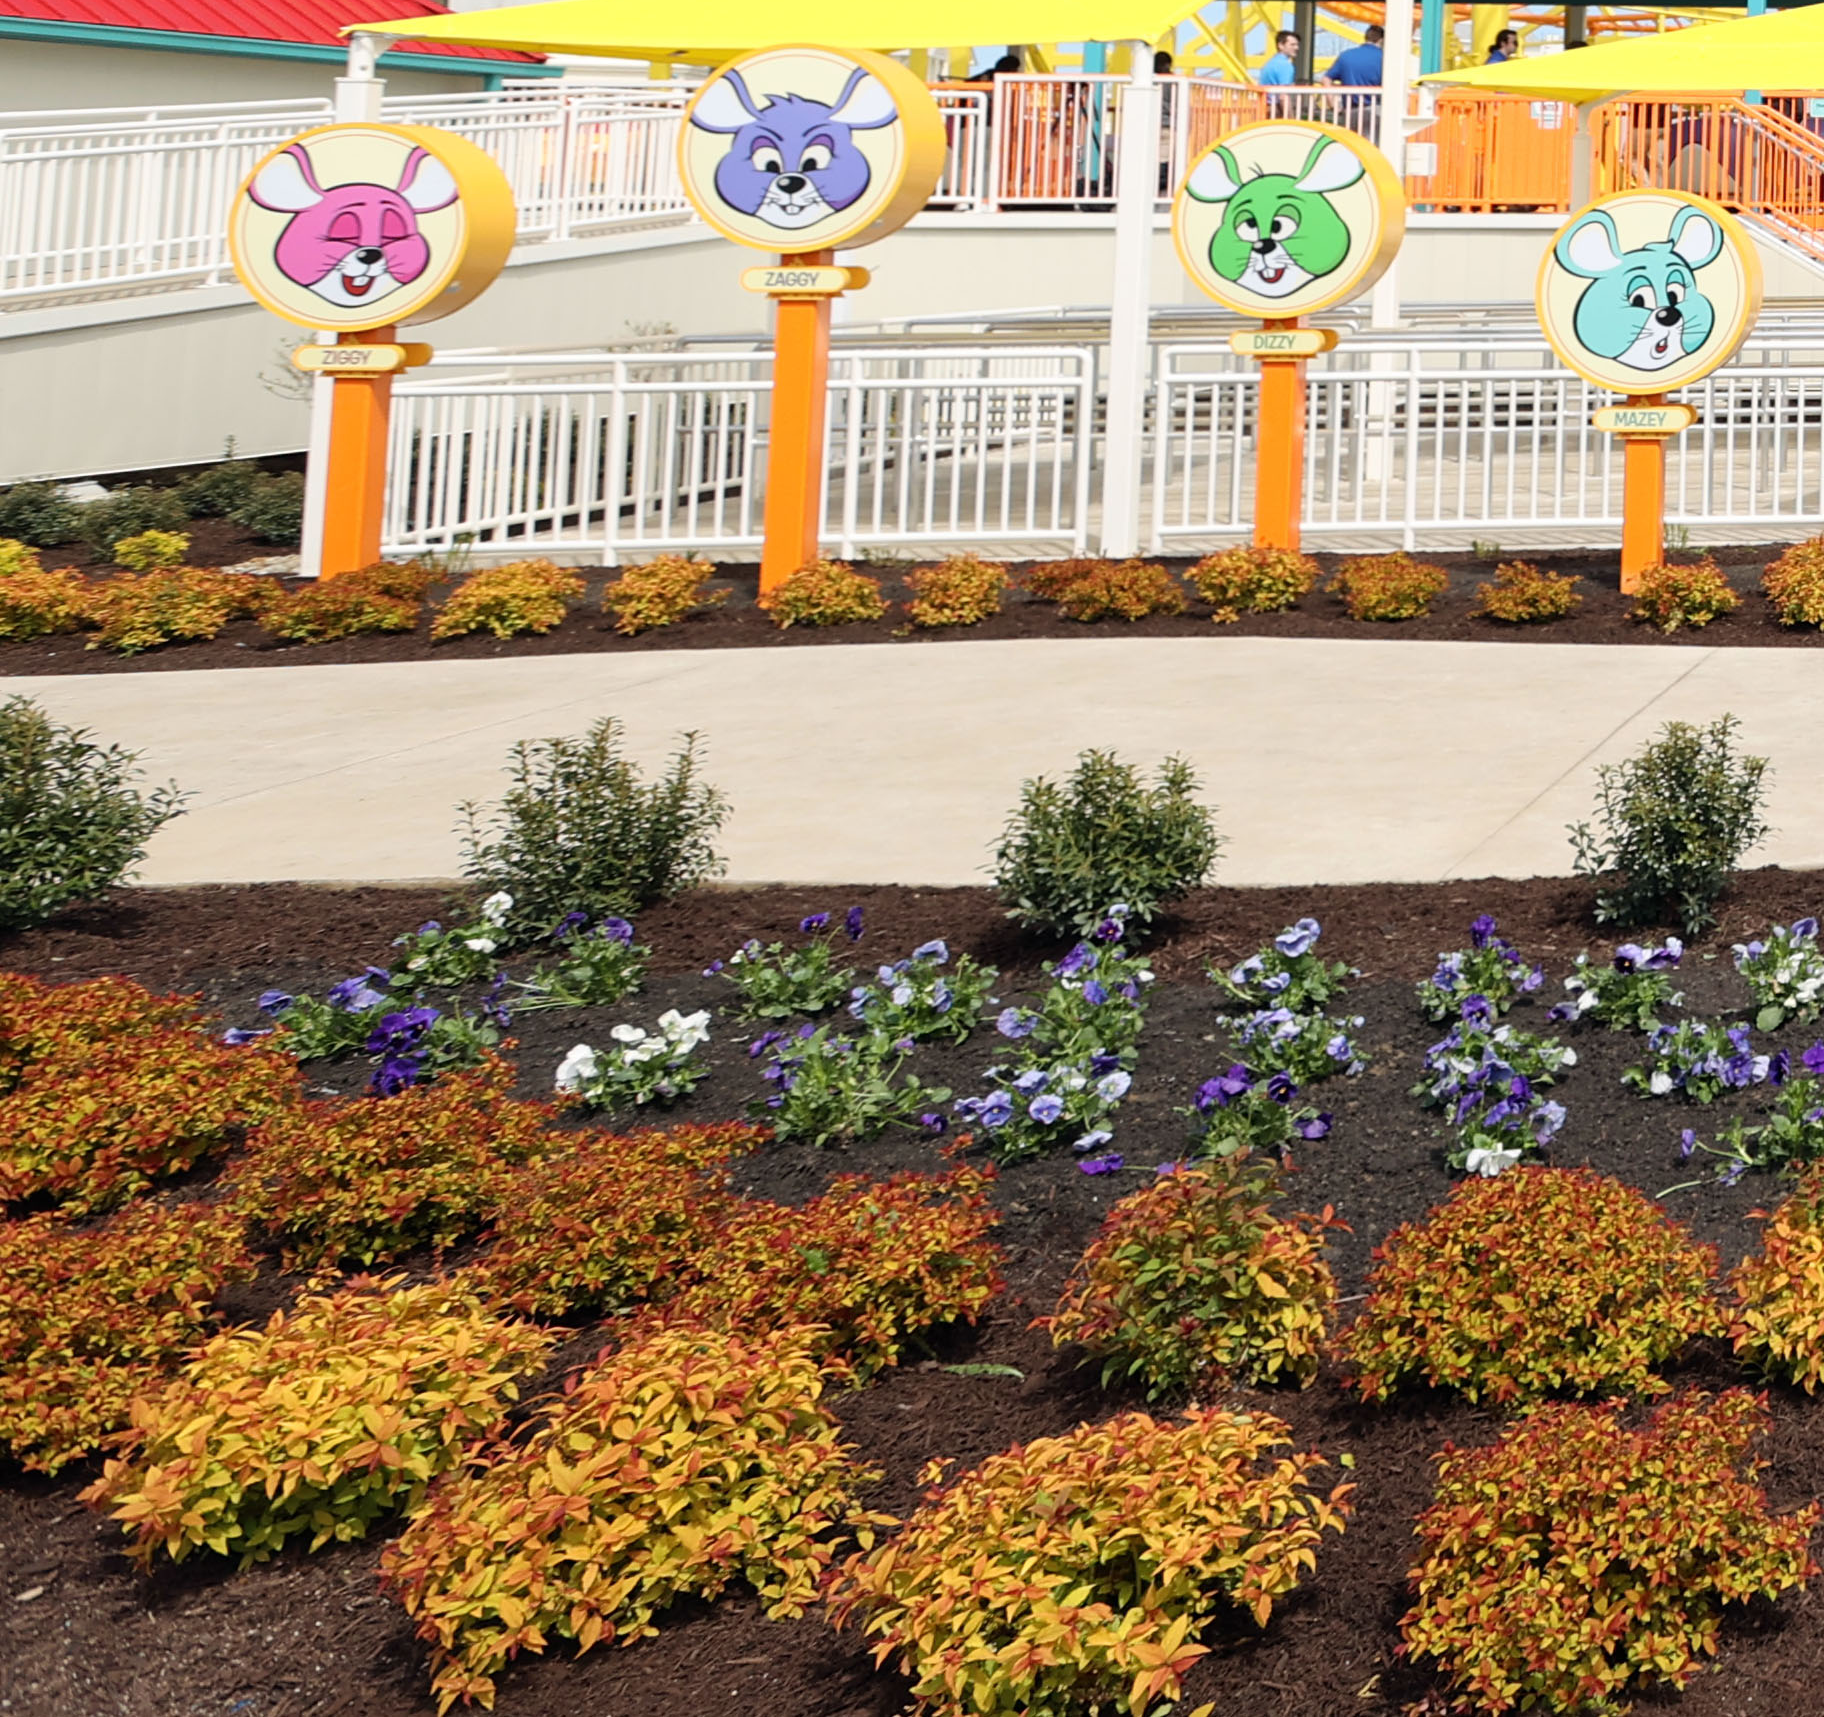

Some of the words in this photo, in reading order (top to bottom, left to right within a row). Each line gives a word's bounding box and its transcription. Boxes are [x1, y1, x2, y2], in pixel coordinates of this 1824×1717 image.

[765, 272, 820, 286] ZAGGY
[1254, 335, 1296, 349] DIZZY
[322, 350, 372, 365] ZIGGY
[1614, 412, 1667, 427] MAZEY
